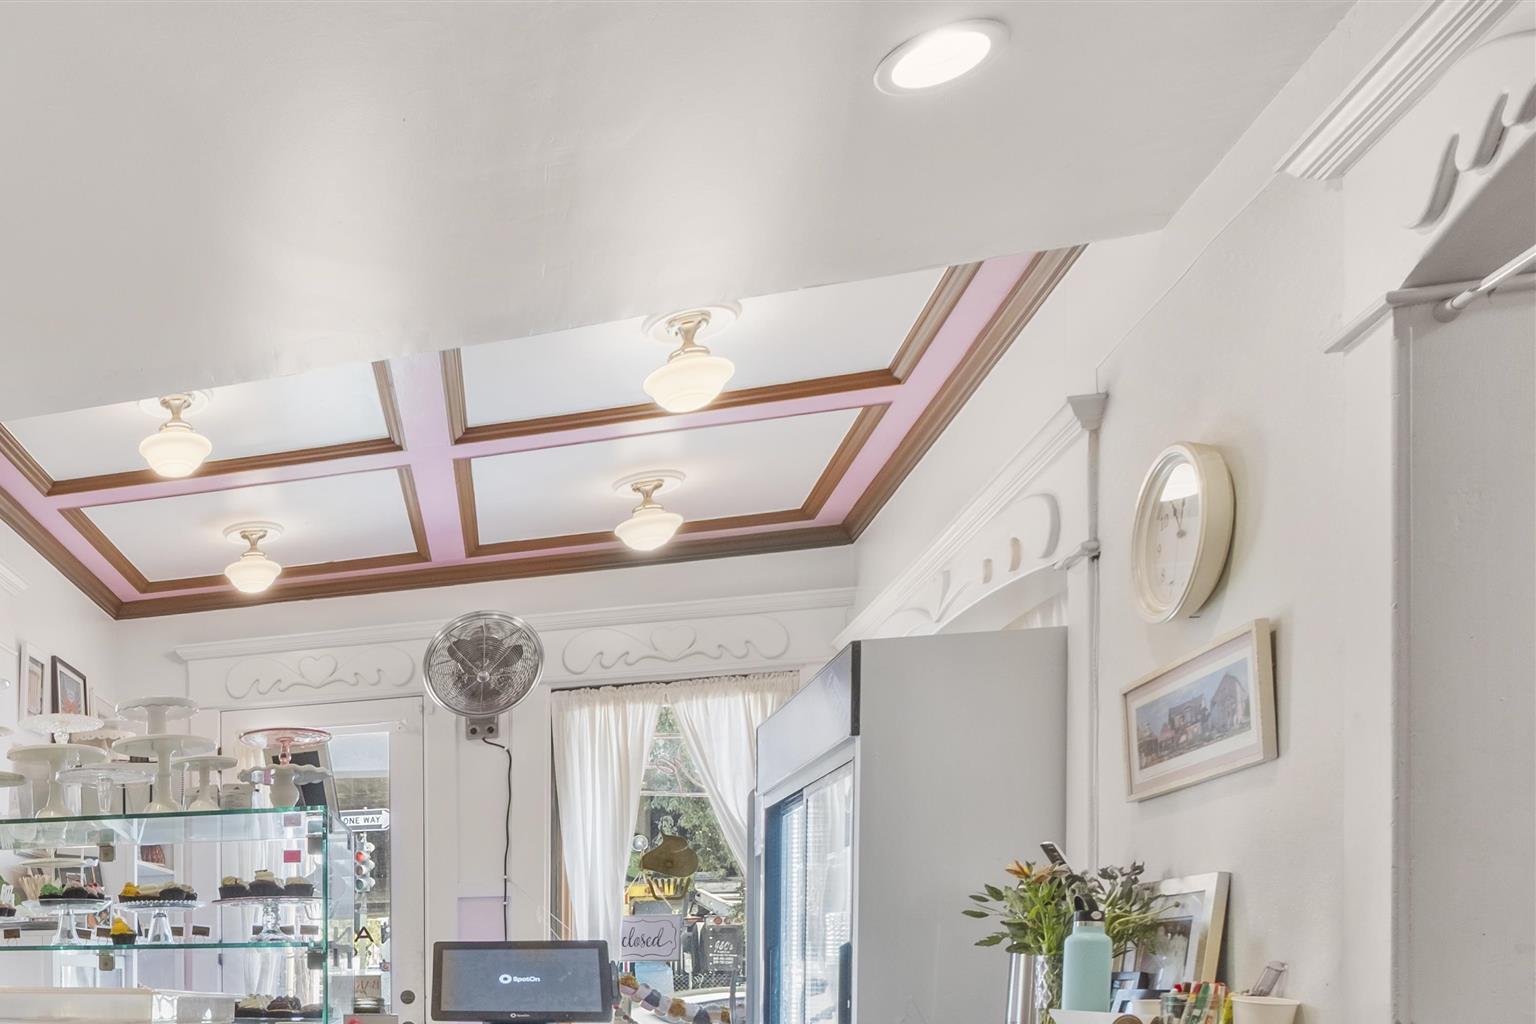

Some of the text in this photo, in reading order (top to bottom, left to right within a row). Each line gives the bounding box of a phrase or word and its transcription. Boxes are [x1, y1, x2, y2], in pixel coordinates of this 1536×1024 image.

[343, 815, 381, 825] ONE WAY
[622, 927, 673, 949] closed
